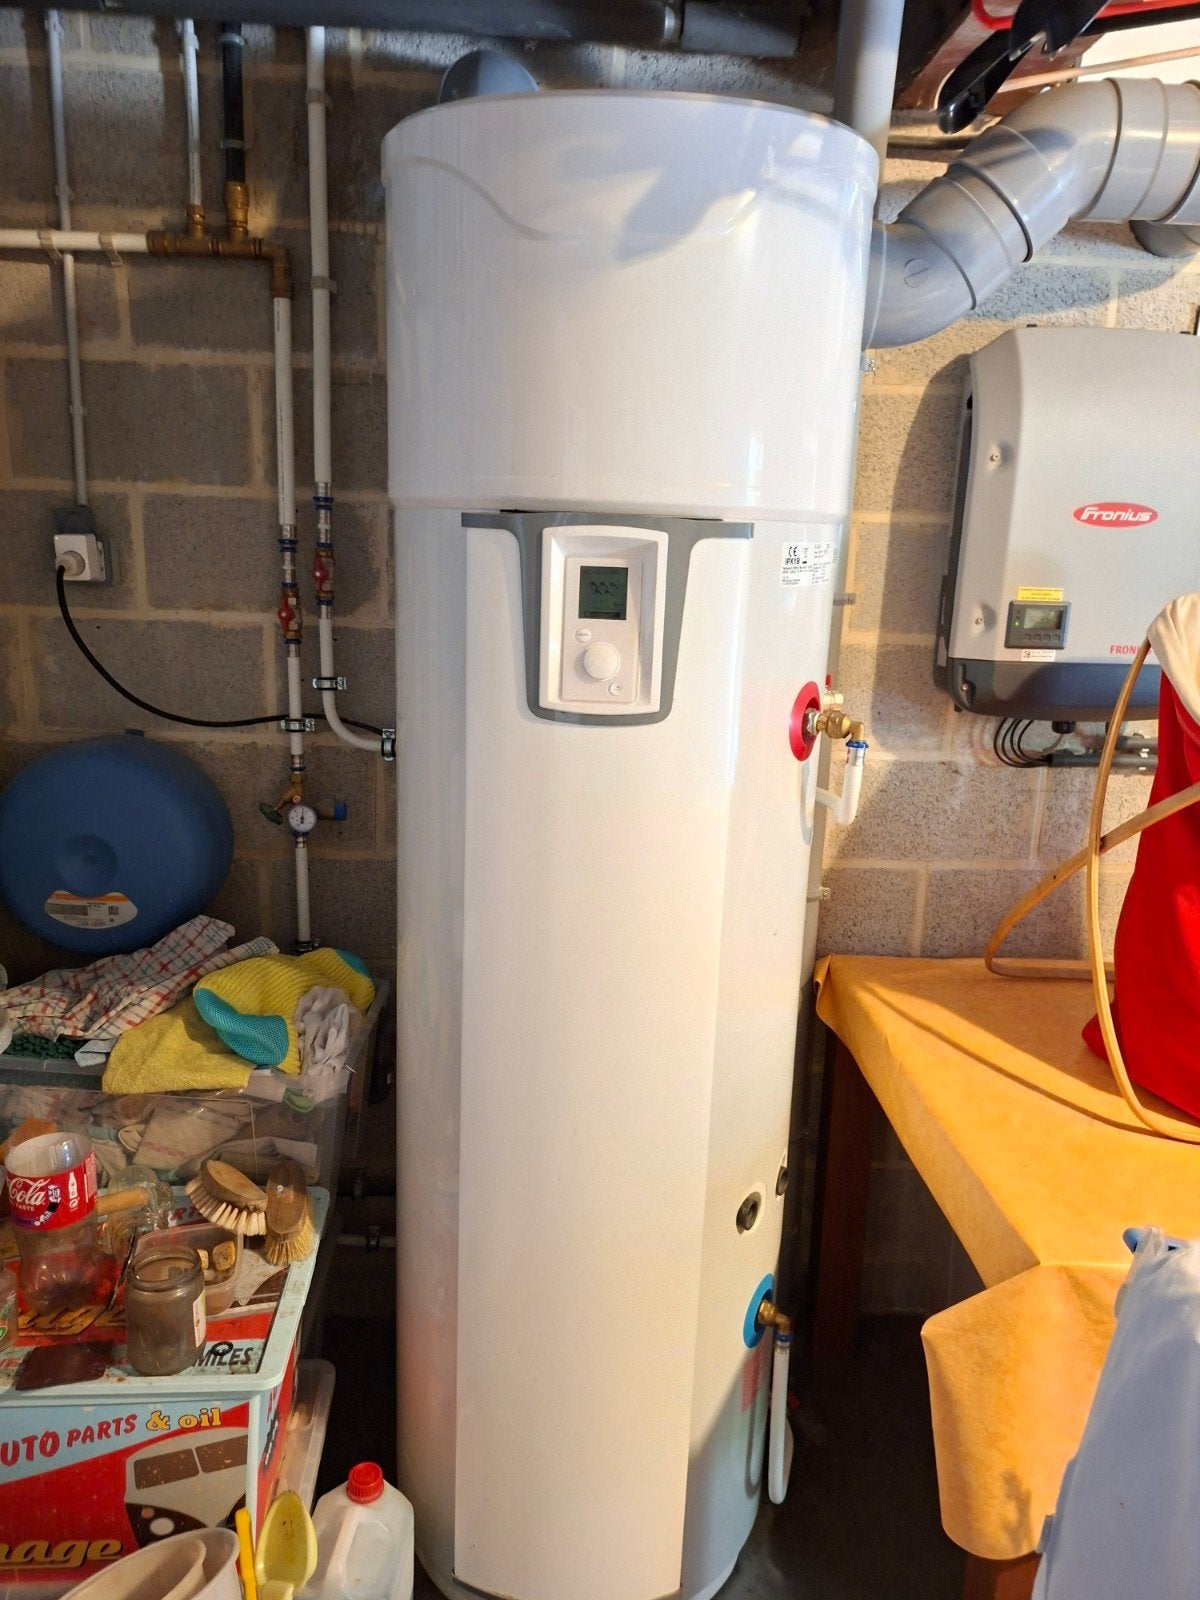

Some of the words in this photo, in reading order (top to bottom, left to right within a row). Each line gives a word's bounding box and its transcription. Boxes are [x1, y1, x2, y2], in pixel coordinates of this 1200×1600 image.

[1080, 507, 1152, 521] Fronius
[9, 1177, 51, 1206] Cola
[66, 1413, 137, 1448] PARTS
[146, 1410, 170, 1431] &
[178, 1407, 222, 1429] oil
